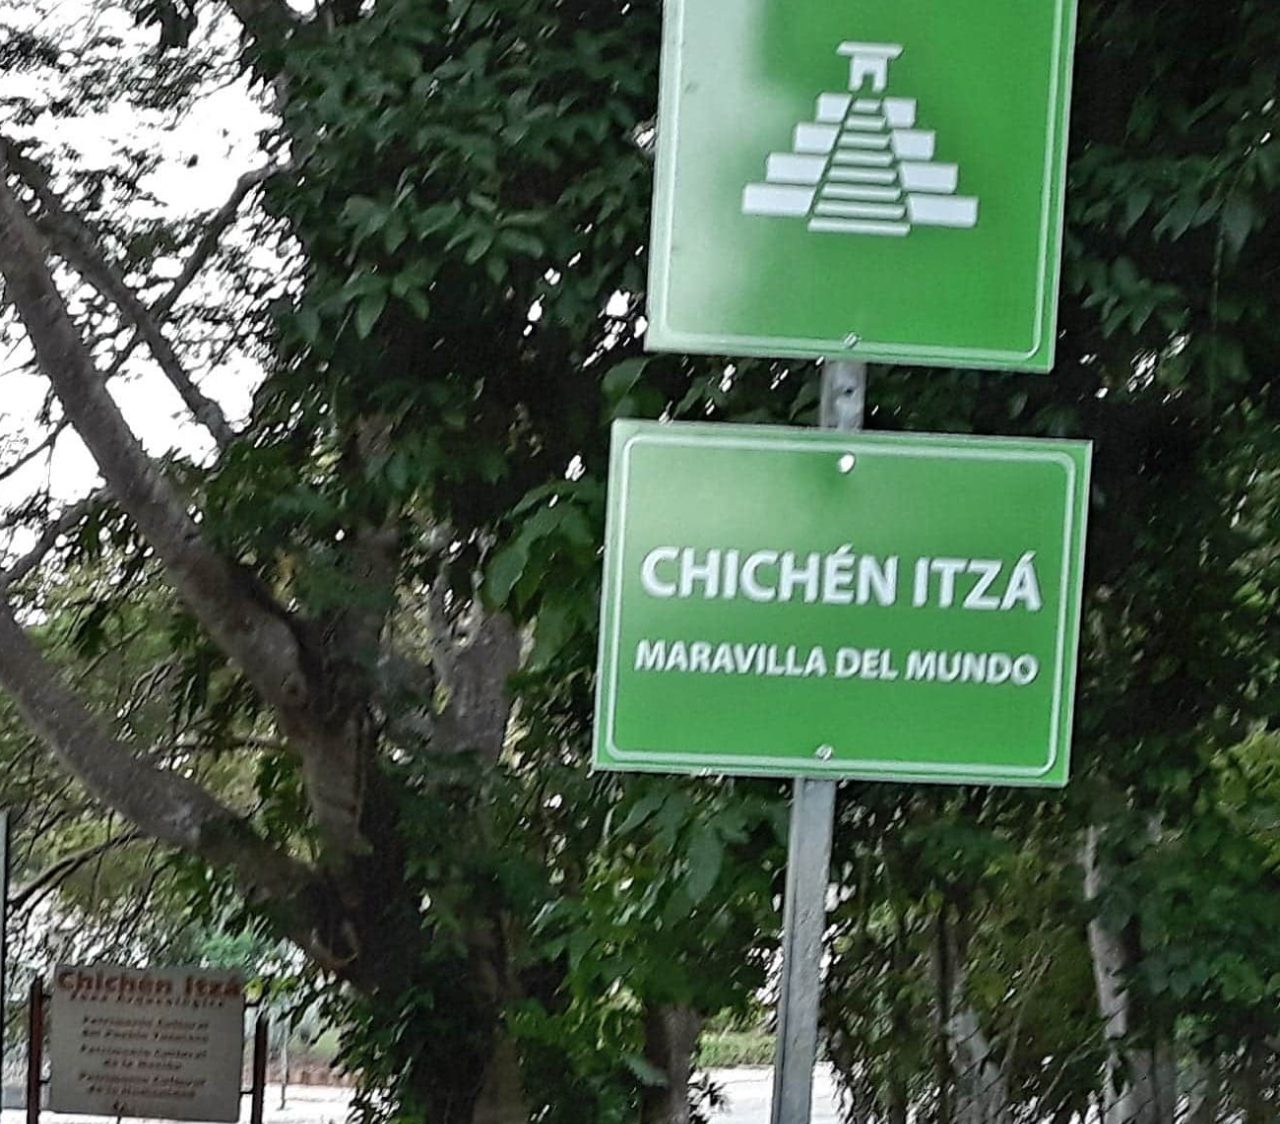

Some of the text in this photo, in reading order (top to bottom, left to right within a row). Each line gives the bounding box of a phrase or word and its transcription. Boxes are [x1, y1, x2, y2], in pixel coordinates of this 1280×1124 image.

[640, 543, 1043, 612] CHICHÉN ITZÁ
[635, 639, 1039, 686] MARAVILLA DEL MUNDO
